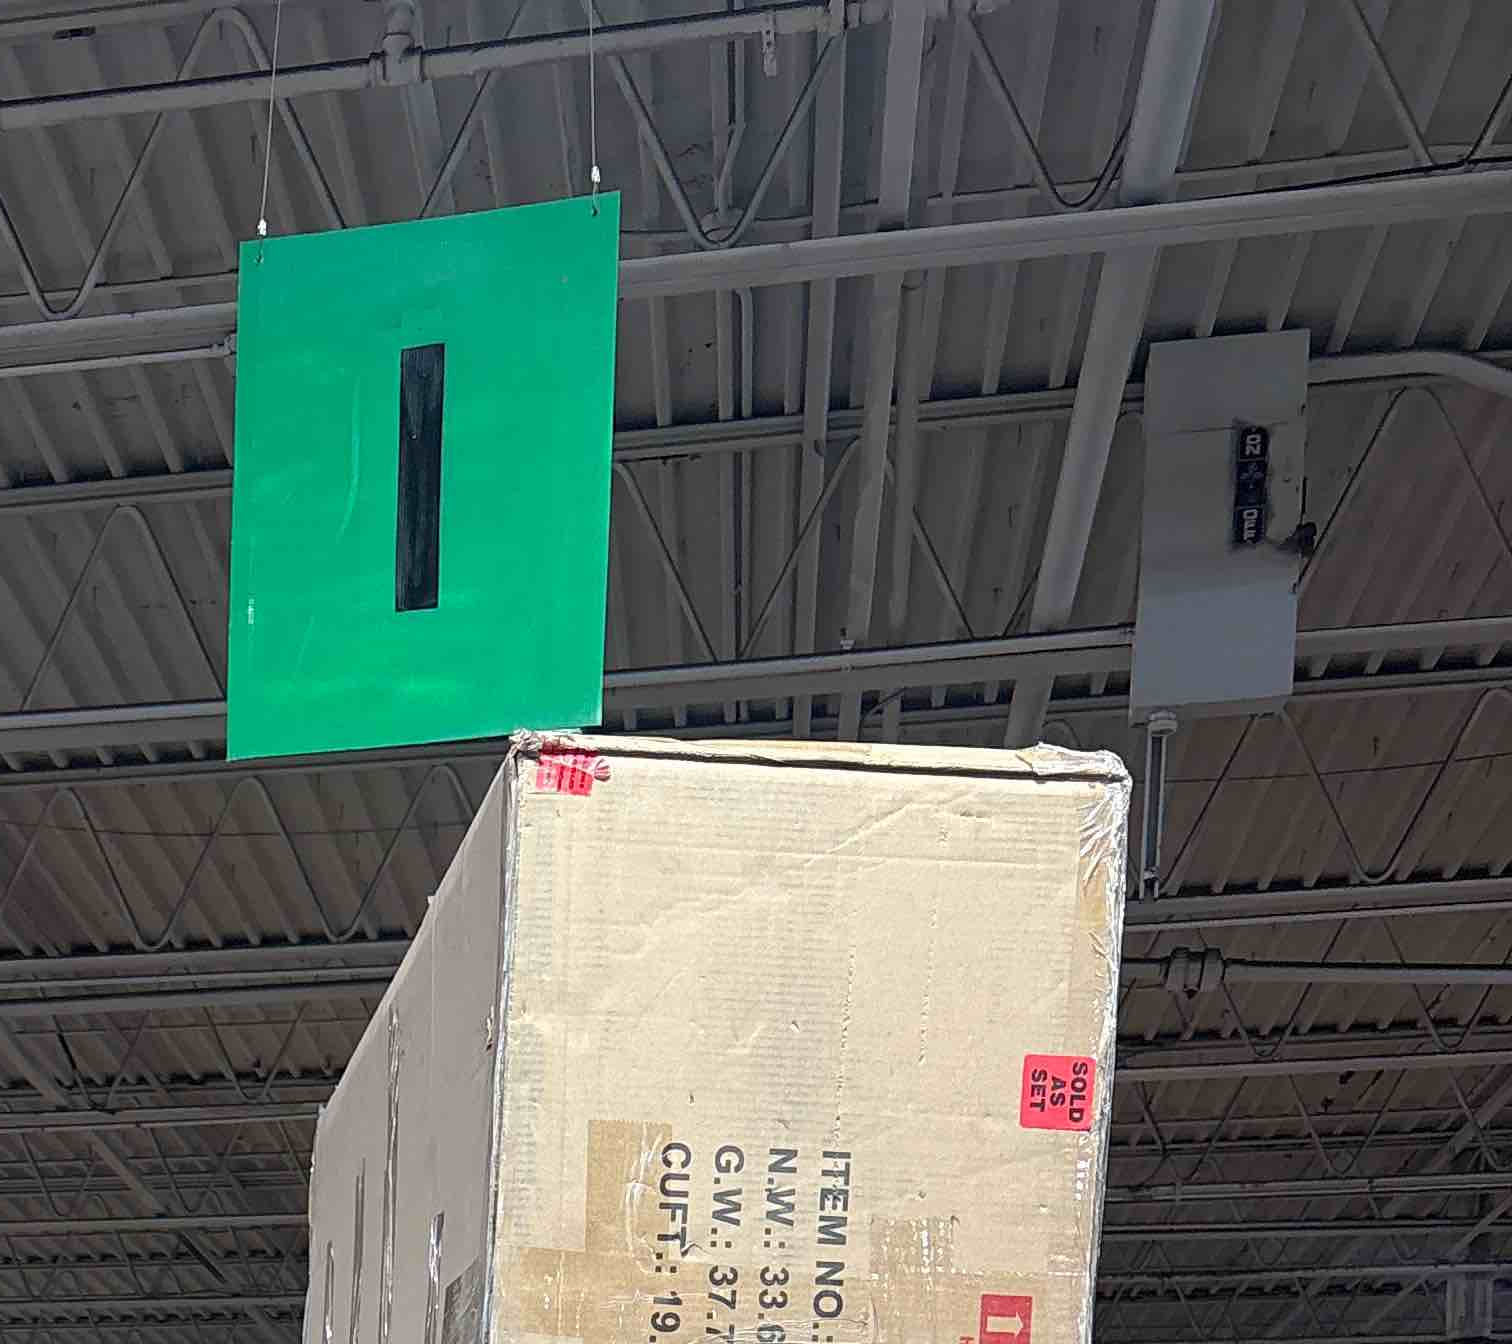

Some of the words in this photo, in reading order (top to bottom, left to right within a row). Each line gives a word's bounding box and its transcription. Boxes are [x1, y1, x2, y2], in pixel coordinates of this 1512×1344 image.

[1245, 433, 1262, 456] ON
[1243, 508, 1258, 541] OFF
[1030, 1068, 1047, 1112] SET
[1050, 1076, 1066, 1106] AS
[1069, 1062, 1088, 1123] SOLD
[653, 1142, 693, 1275] CUFT.:
[710, 1145, 746, 1250] G.W.:
[763, 1147, 798, 1248] N.W.:
[818, 1151, 852, 1246] ITEM
[812, 1261, 846, 1344] NO.:
